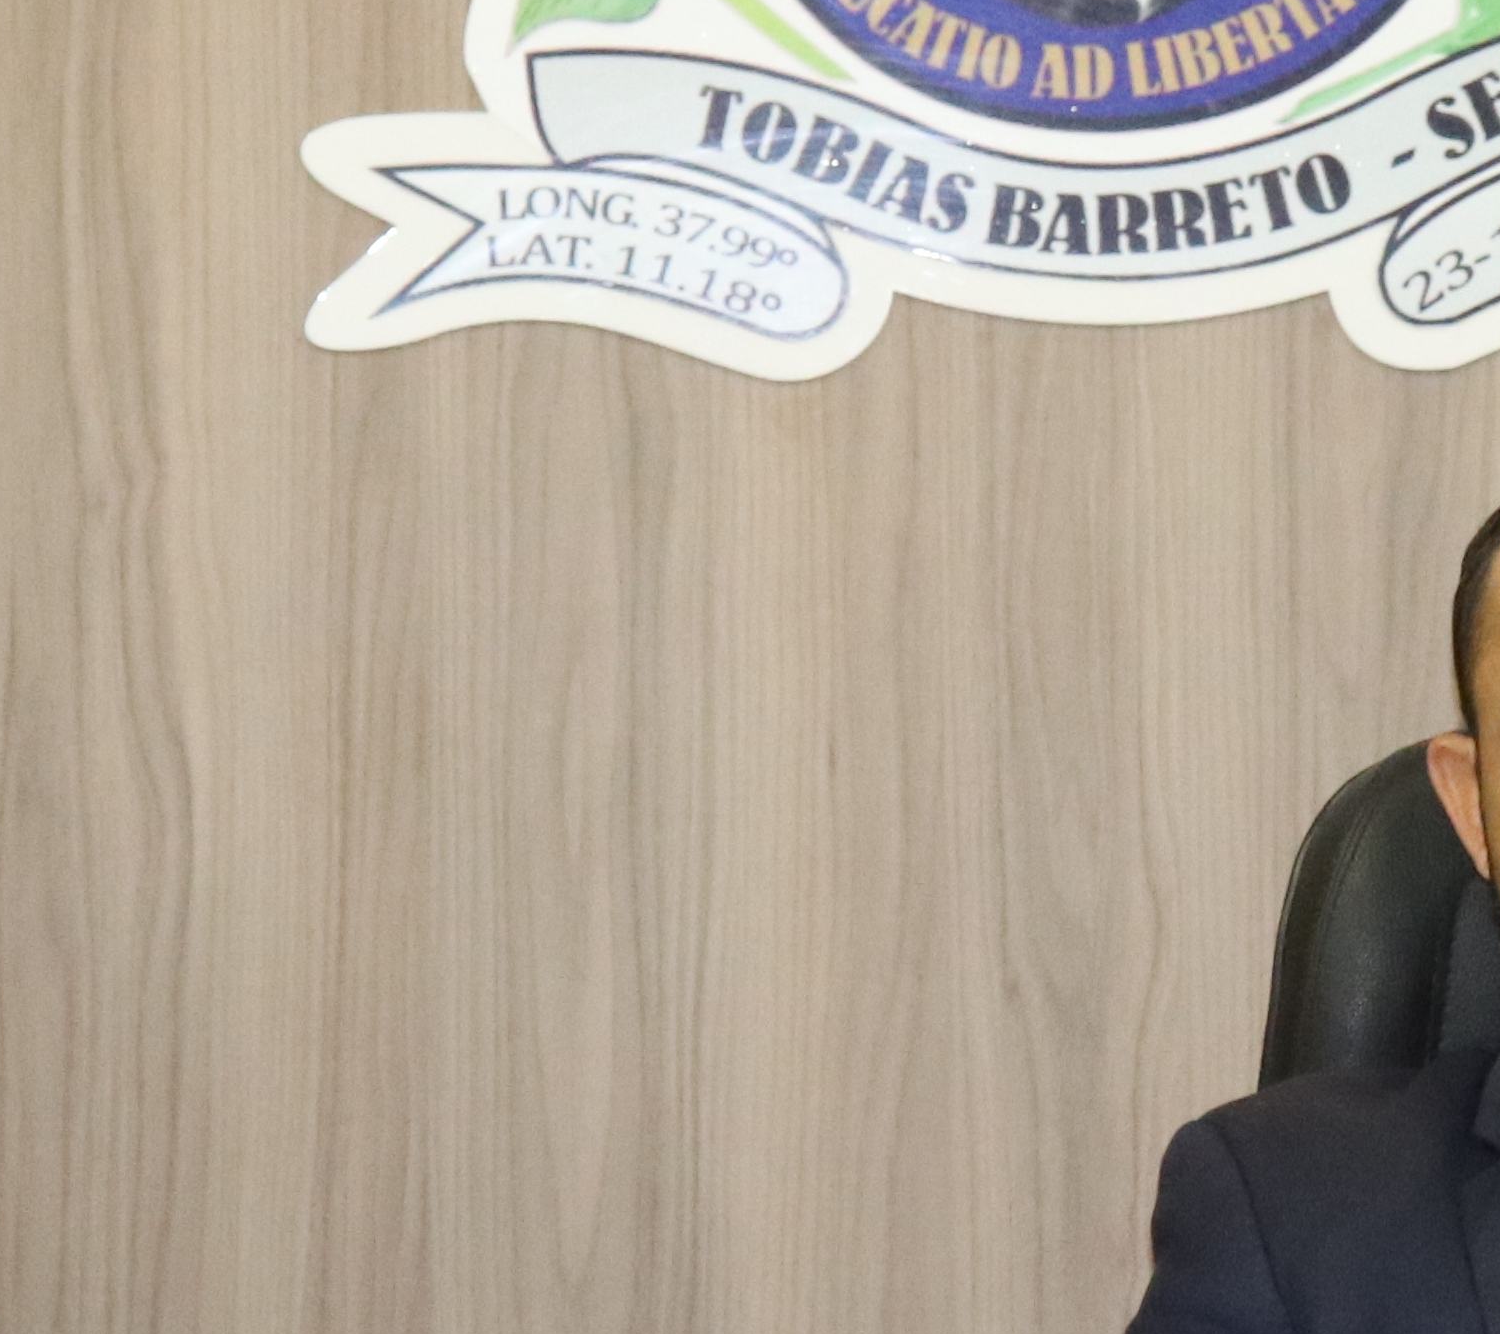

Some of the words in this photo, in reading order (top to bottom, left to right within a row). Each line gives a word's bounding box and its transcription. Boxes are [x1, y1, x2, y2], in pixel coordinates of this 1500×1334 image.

[1032, 47, 1115, 101] AD
[698, 83, 974, 237] TOBIAS
[987, 152, 1351, 255] BARRETO
[499, 185, 638, 229] LONG.
[487, 234, 593, 271] LAT.
